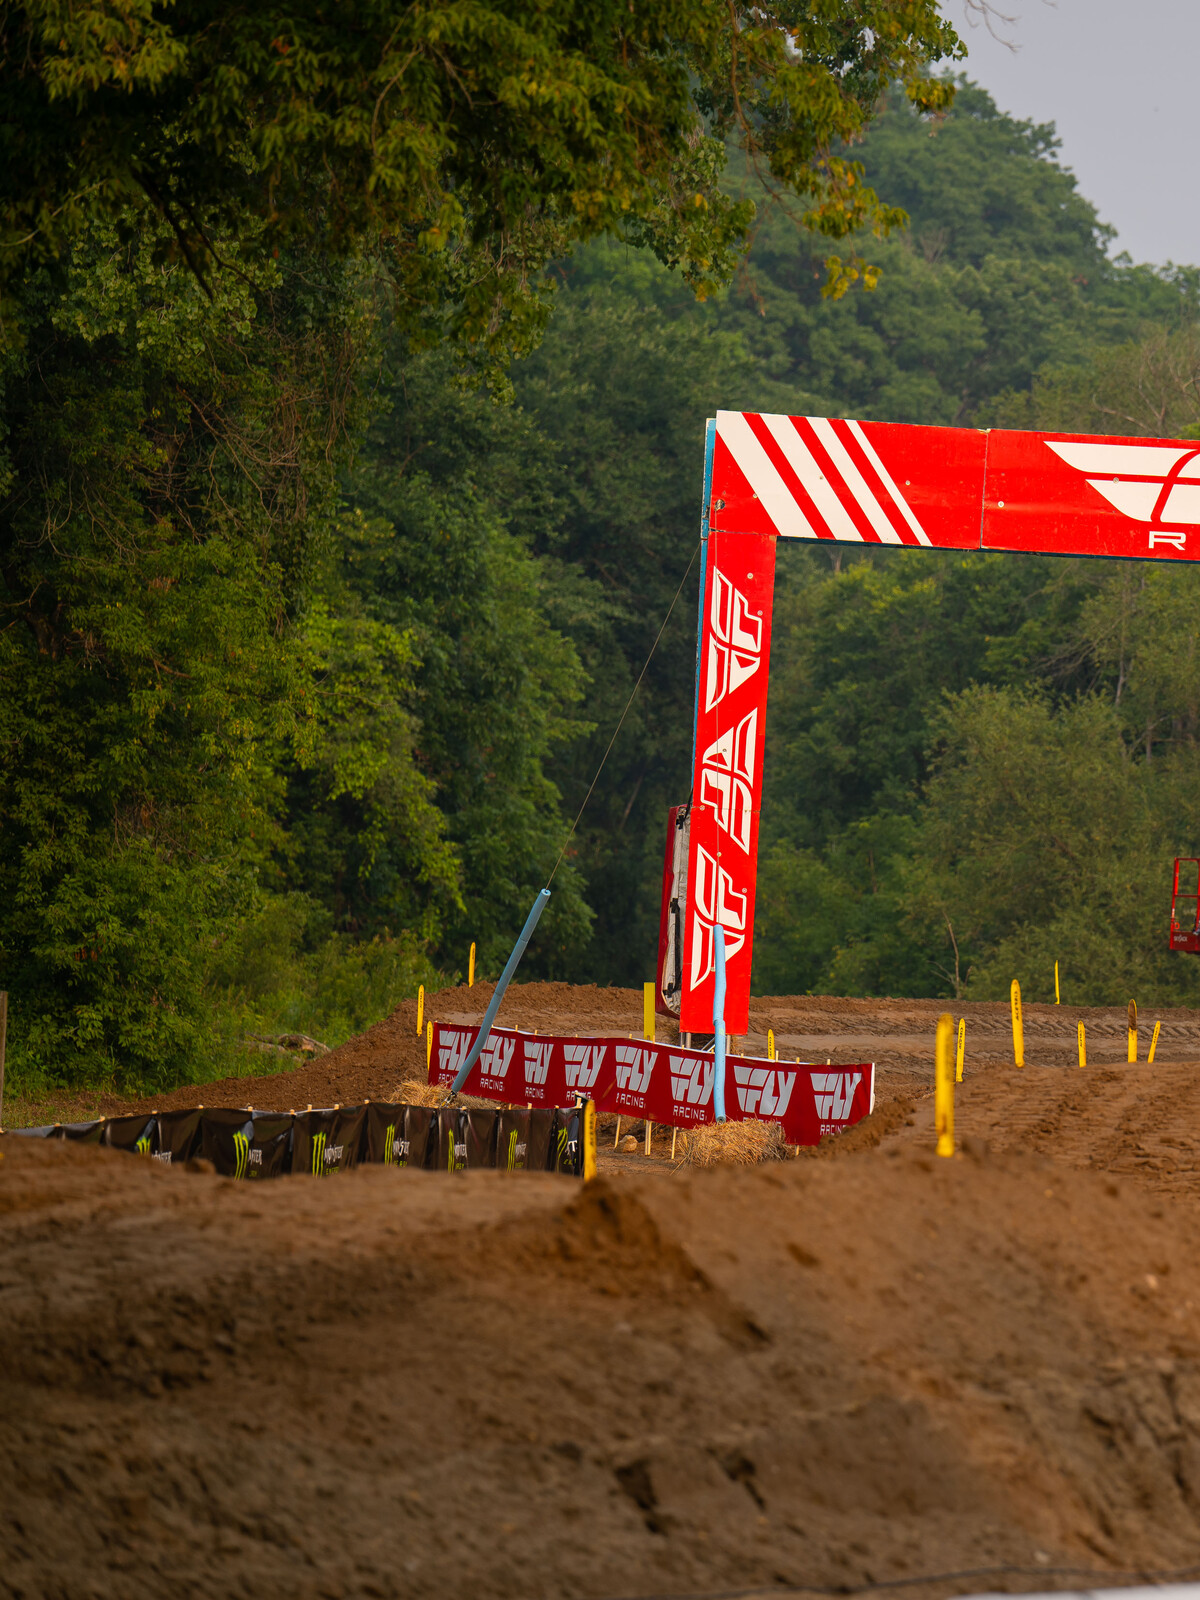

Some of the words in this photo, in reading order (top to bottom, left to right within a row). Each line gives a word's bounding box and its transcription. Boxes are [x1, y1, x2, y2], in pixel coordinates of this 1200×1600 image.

[479, 1034, 517, 1078] FLY
[523, 1040, 555, 1085] FLY
[563, 1044, 608, 1088] FLY
[615, 1045, 659, 1094] FLY
[668, 1054, 715, 1106] FLY
[733, 1065, 798, 1117] FLY
[809, 1072, 863, 1120] FLY
[673, 1104, 706, 1121] RACING
